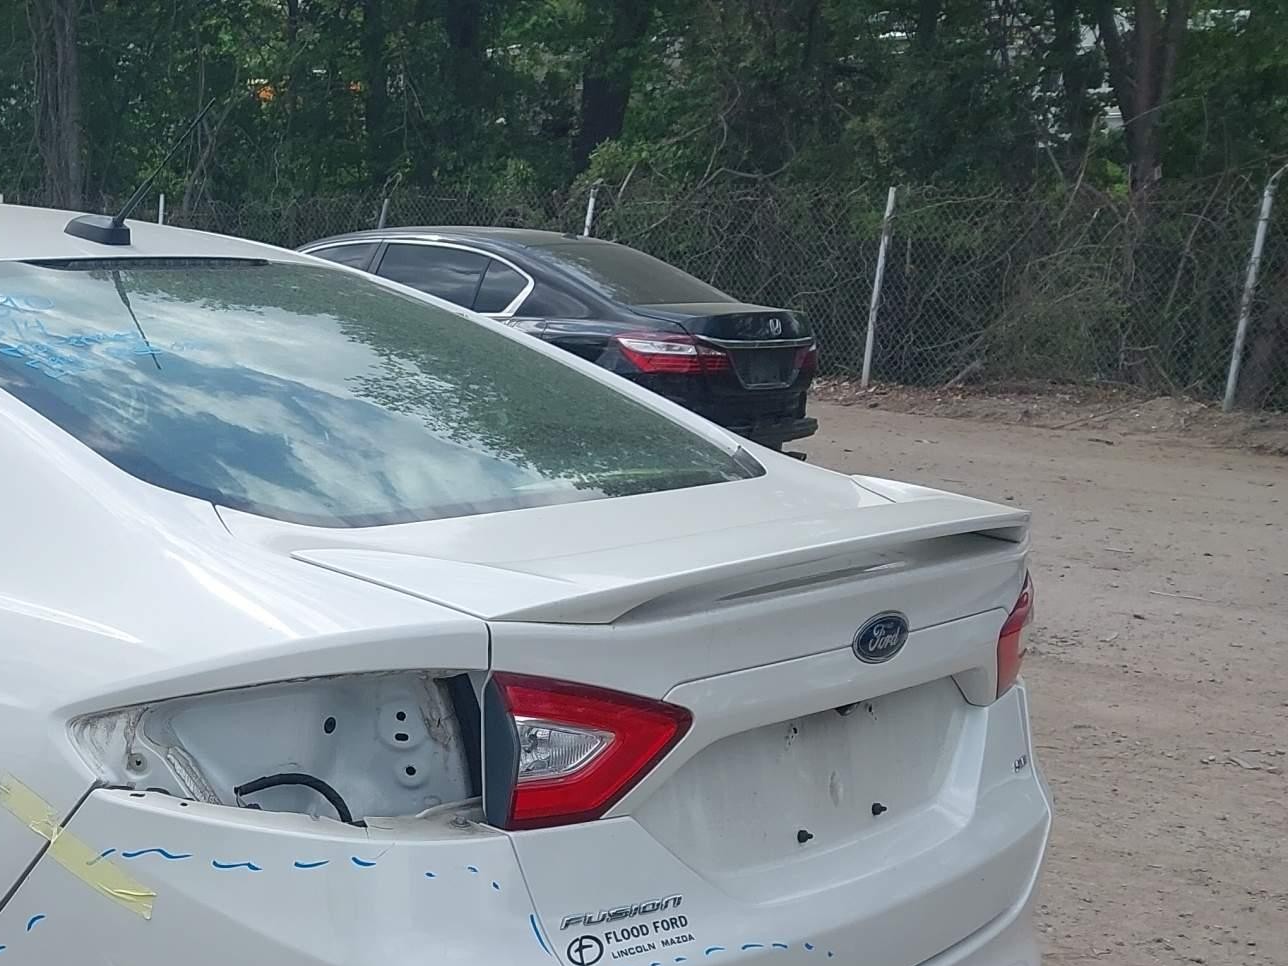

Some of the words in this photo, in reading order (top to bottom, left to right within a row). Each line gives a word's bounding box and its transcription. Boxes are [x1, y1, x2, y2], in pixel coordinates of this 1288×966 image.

[868, 623, 900, 652] Ford
[560, 894, 683, 930] FUSION
[605, 924, 650, 944] FLOOD
[653, 914, 688, 934] FORD
[611, 942, 657, 959] LINCOLN
[661, 933, 695, 948] MAZDA
